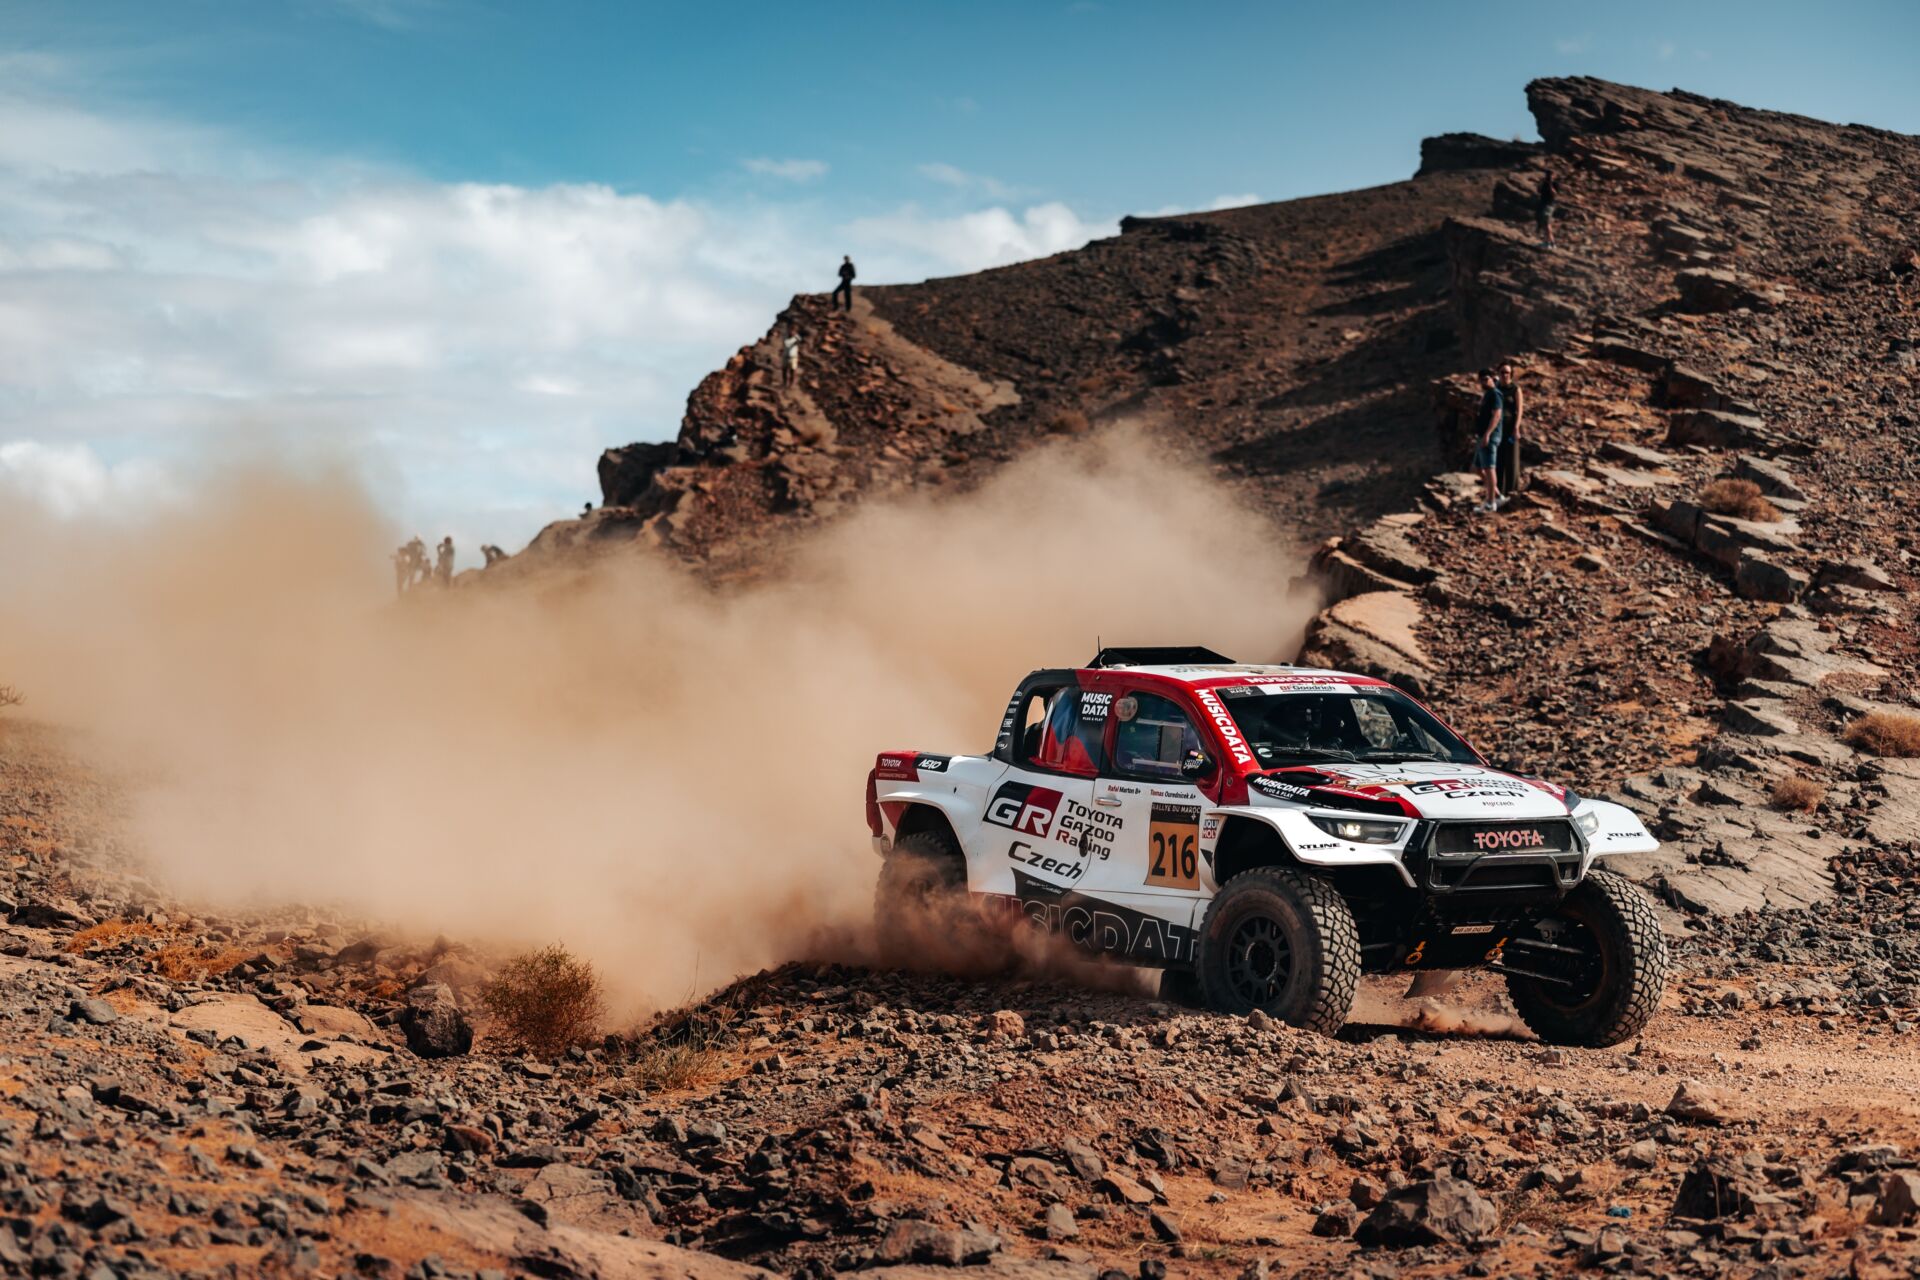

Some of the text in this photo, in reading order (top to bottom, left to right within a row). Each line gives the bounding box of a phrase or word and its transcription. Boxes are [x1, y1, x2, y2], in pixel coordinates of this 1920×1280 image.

[1081, 692, 1113, 705] MUSIC
[1082, 704, 1108, 717] DATA
[1194, 689, 1252, 765] MUSICDATA
[881, 758, 902, 767] TOYOTA
[1254, 776, 1312, 798] MUSICDATA
[1263, 786, 1276, 794] PLUG
[1281, 790, 1294, 799] PLAY
[1445, 790, 1524, 799] Czech
[987, 797, 1053, 836] GR
[1067, 799, 1123, 830] TOYOTA
[1181, 806, 1201, 814] MAROC
[1060, 815, 1115, 843] GAZOO
[1474, 829, 1544, 849] TOYOTA
[1008, 840, 1083, 880] Czech
[1151, 831, 1196, 880] 216
